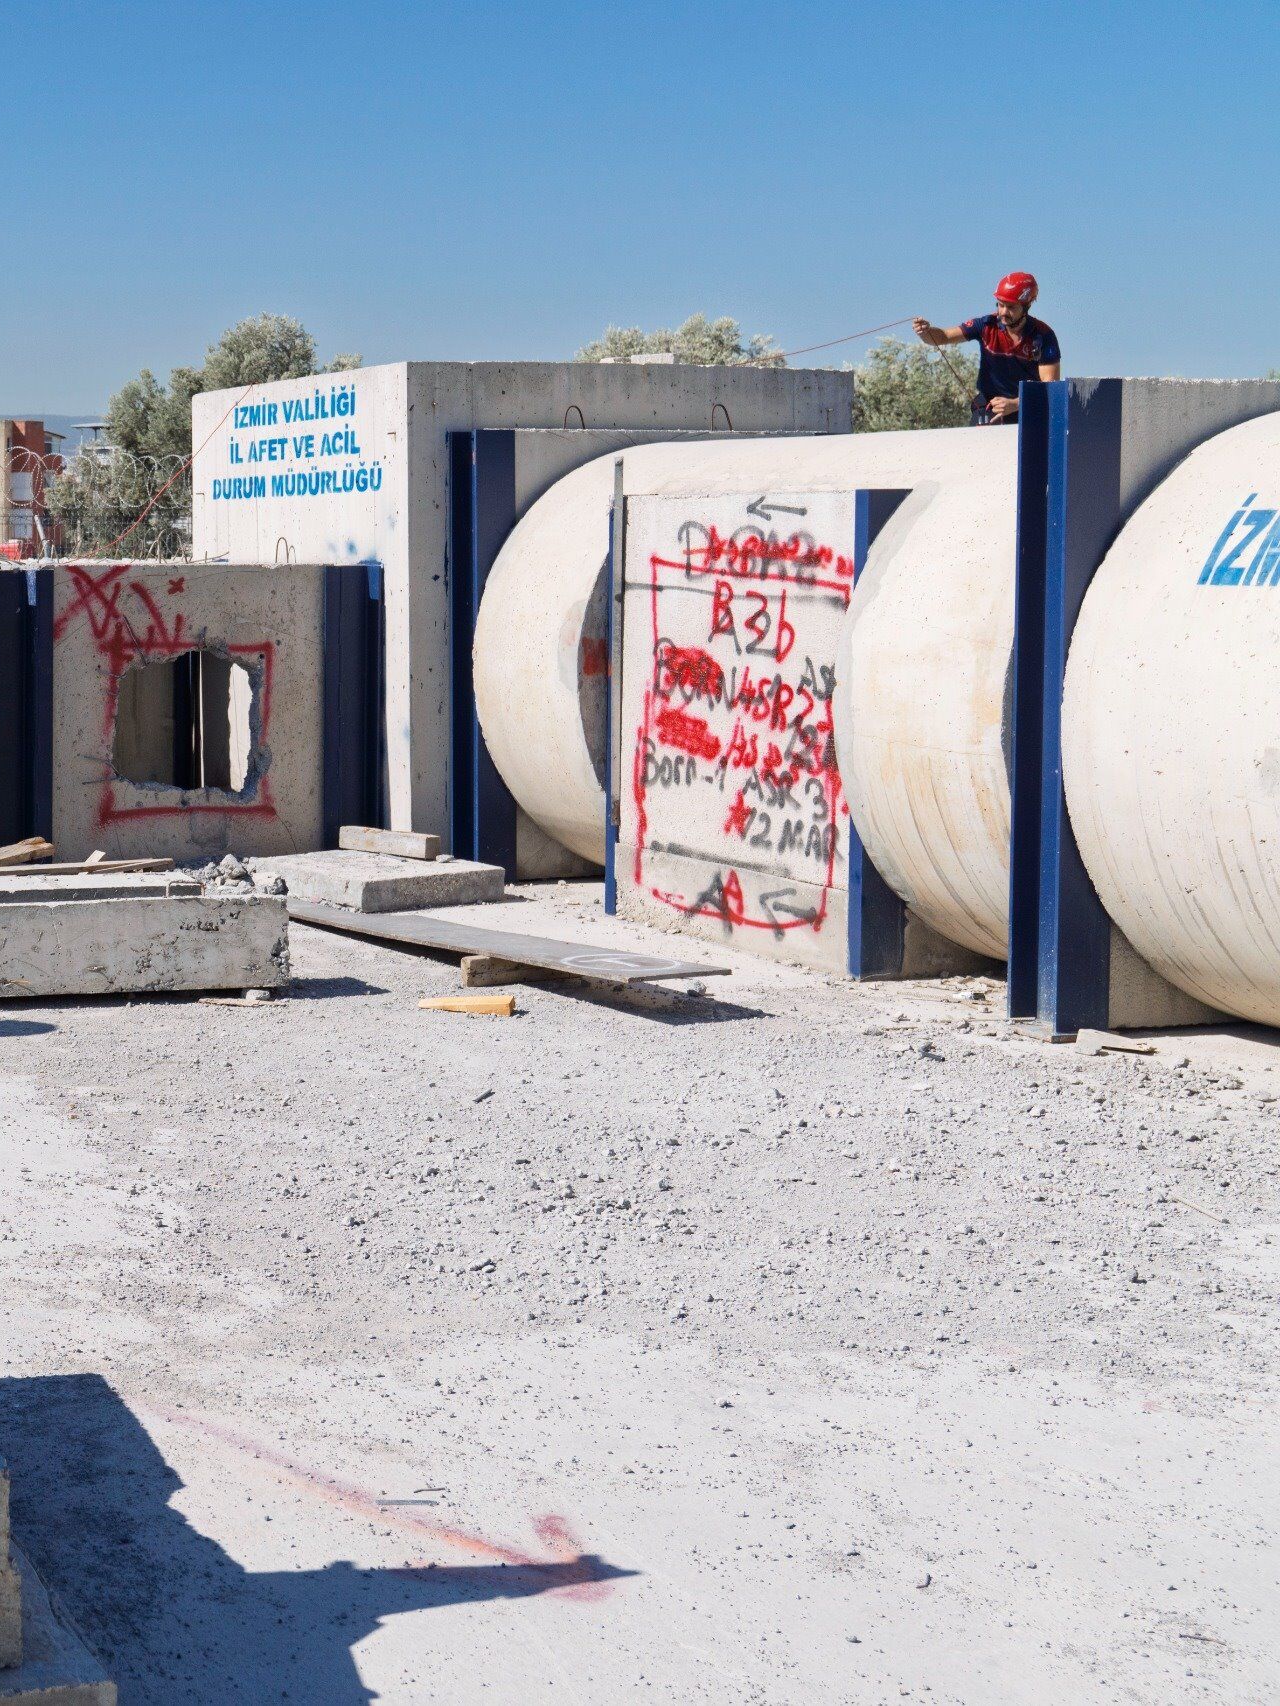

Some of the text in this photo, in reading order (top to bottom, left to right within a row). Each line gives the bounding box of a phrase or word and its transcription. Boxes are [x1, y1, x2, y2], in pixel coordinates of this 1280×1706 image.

[282, 383, 356, 423] VALİLİĞİ
[230, 423, 361, 464] İL AFET VE ACİL
[213, 461, 382, 500] DURUM MÜDÜRLÜĞÜ
